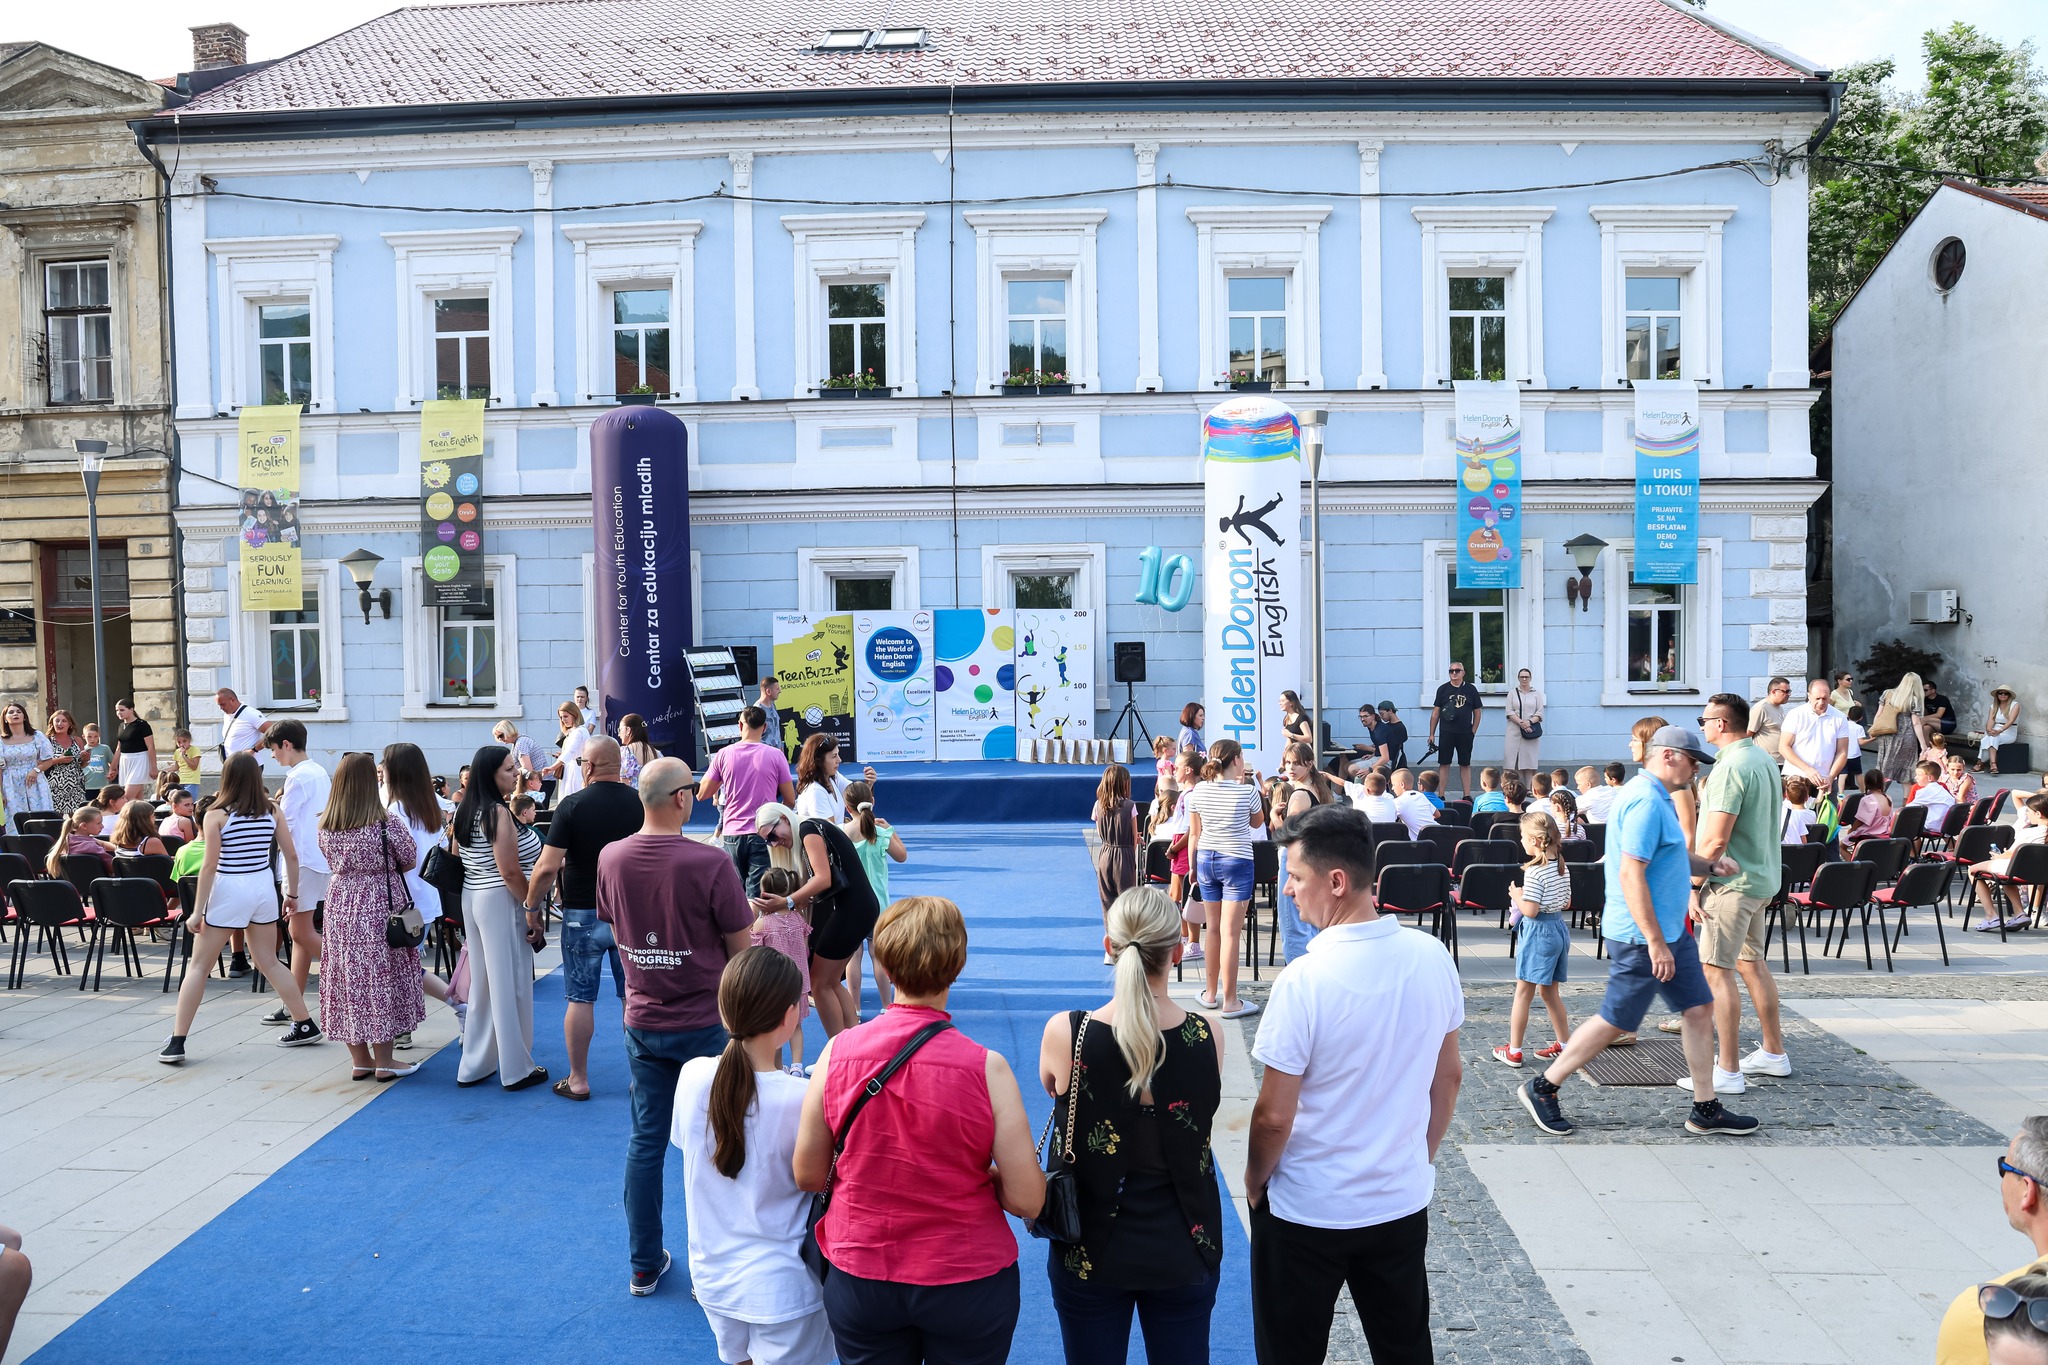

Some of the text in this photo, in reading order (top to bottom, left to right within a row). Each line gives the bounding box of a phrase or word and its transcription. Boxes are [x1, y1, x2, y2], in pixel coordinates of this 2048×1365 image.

[428, 434, 479, 448] Teen English
[250, 444, 278, 454] Teen
[250, 455, 289, 472] English
[1653, 468, 1682, 479] UPIS
[1643, 484, 1692, 496] U TOKU!
[428, 502, 450, 510] Excel
[1660, 540, 1674, 549] ČAS
[250, 554, 292, 562] SERIOUSLY
[257, 564, 285, 576] FUN
[432, 568, 452, 576] goals
[612, 486, 630, 657] Center for Youth Education
[636, 457, 662, 689] Centar za edukaciju mladih
[252, 578, 292, 586] LEARNING!
[1134, 546, 1194, 612] 10
[1252, 558, 1288, 658] English
[1221, 548, 1256, 750] Helen Doron
[882, 660, 906, 668] English
[780, 682, 810, 690] SERIOUSLY
[618, 944, 634, 954] SMALL
[628, 952, 682, 966] PROGRESS
